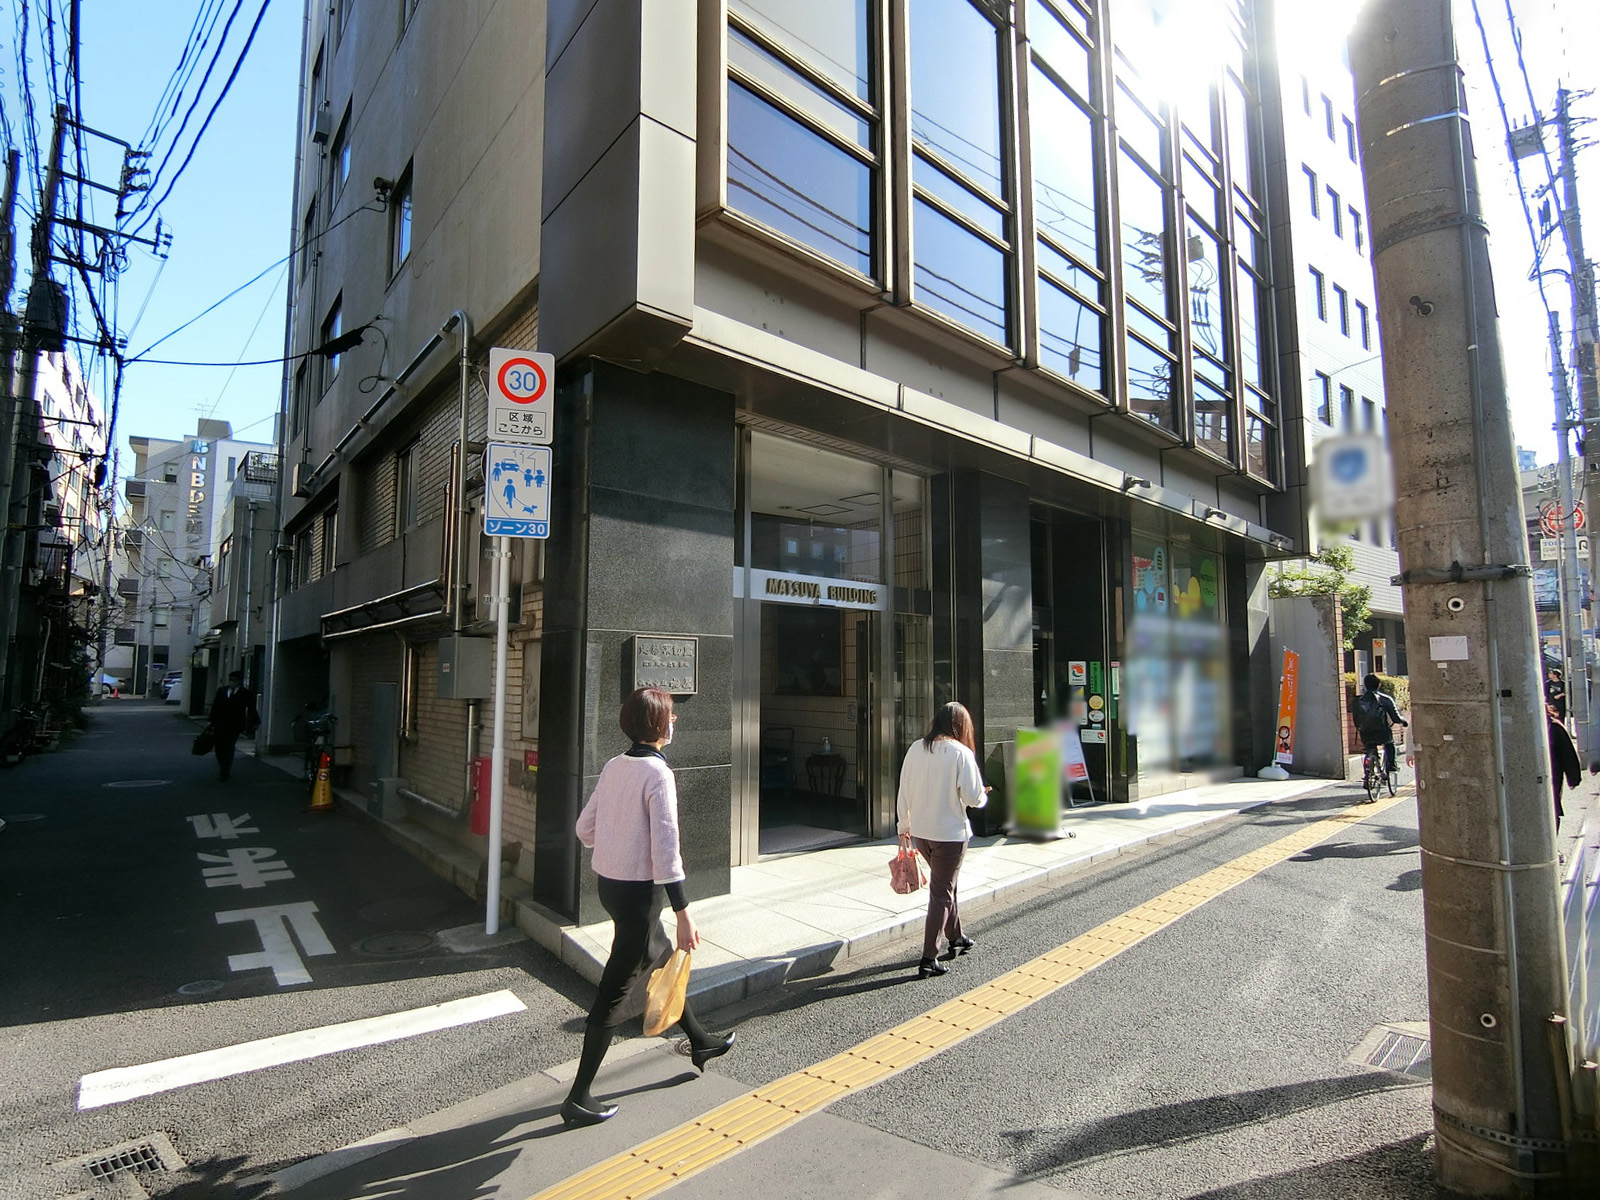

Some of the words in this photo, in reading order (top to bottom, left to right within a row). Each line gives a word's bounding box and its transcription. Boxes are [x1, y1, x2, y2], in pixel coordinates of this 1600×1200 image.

[509, 370, 536, 392] 30
[509, 412, 534, 424] 区域
[498, 423, 543, 436] ここから
[489, 521, 545, 535] ゾーン30
[766, 578, 821, 598] MATSUYA
[828, 586, 877, 604] BUILDING
[186, 812, 337, 986] 止まれ
